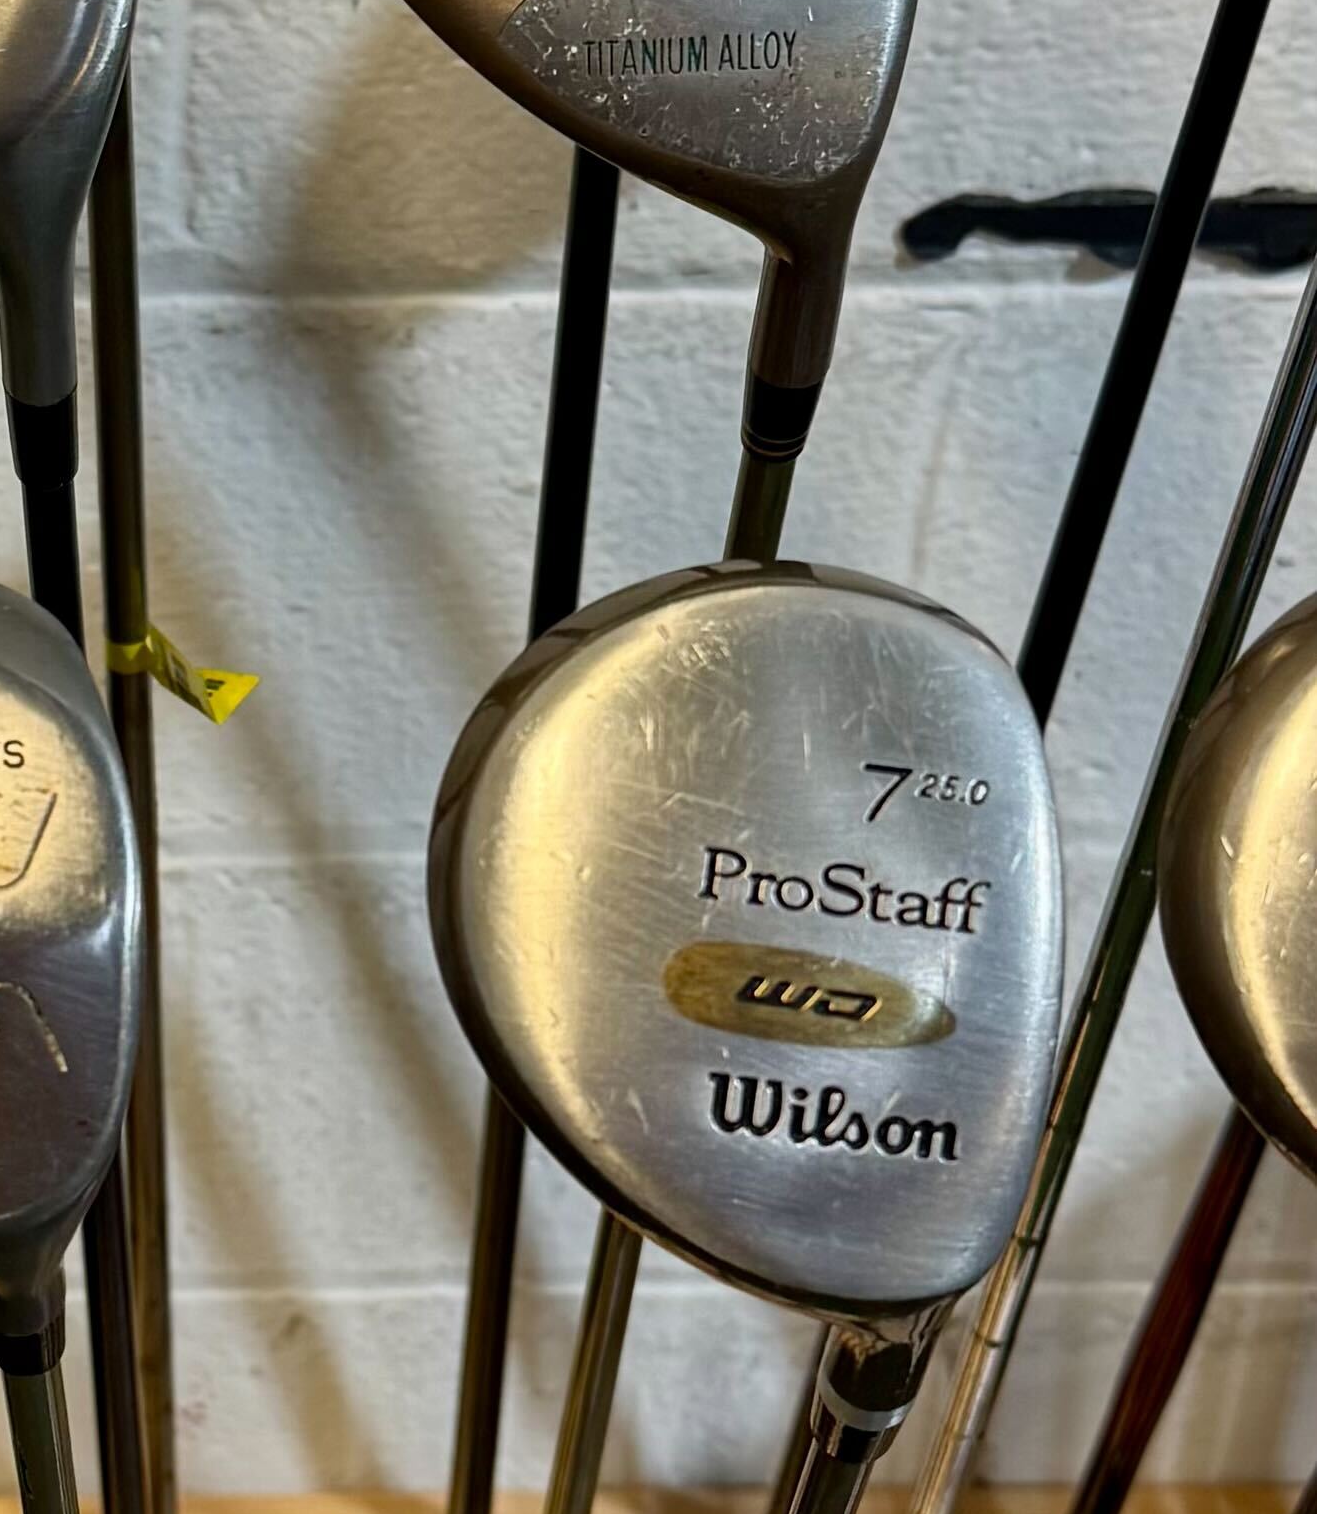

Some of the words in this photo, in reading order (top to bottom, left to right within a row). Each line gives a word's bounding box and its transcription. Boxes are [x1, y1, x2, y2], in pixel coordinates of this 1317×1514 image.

[583, 36, 709, 77] TITANIUM
[717, 30, 797, 72] ALLOY
[863, 762, 913, 823] 7
[914, 771, 990, 806] 25.0
[698, 846, 990, 934] ProStaff
[709, 1072, 959, 1162] Wilson
